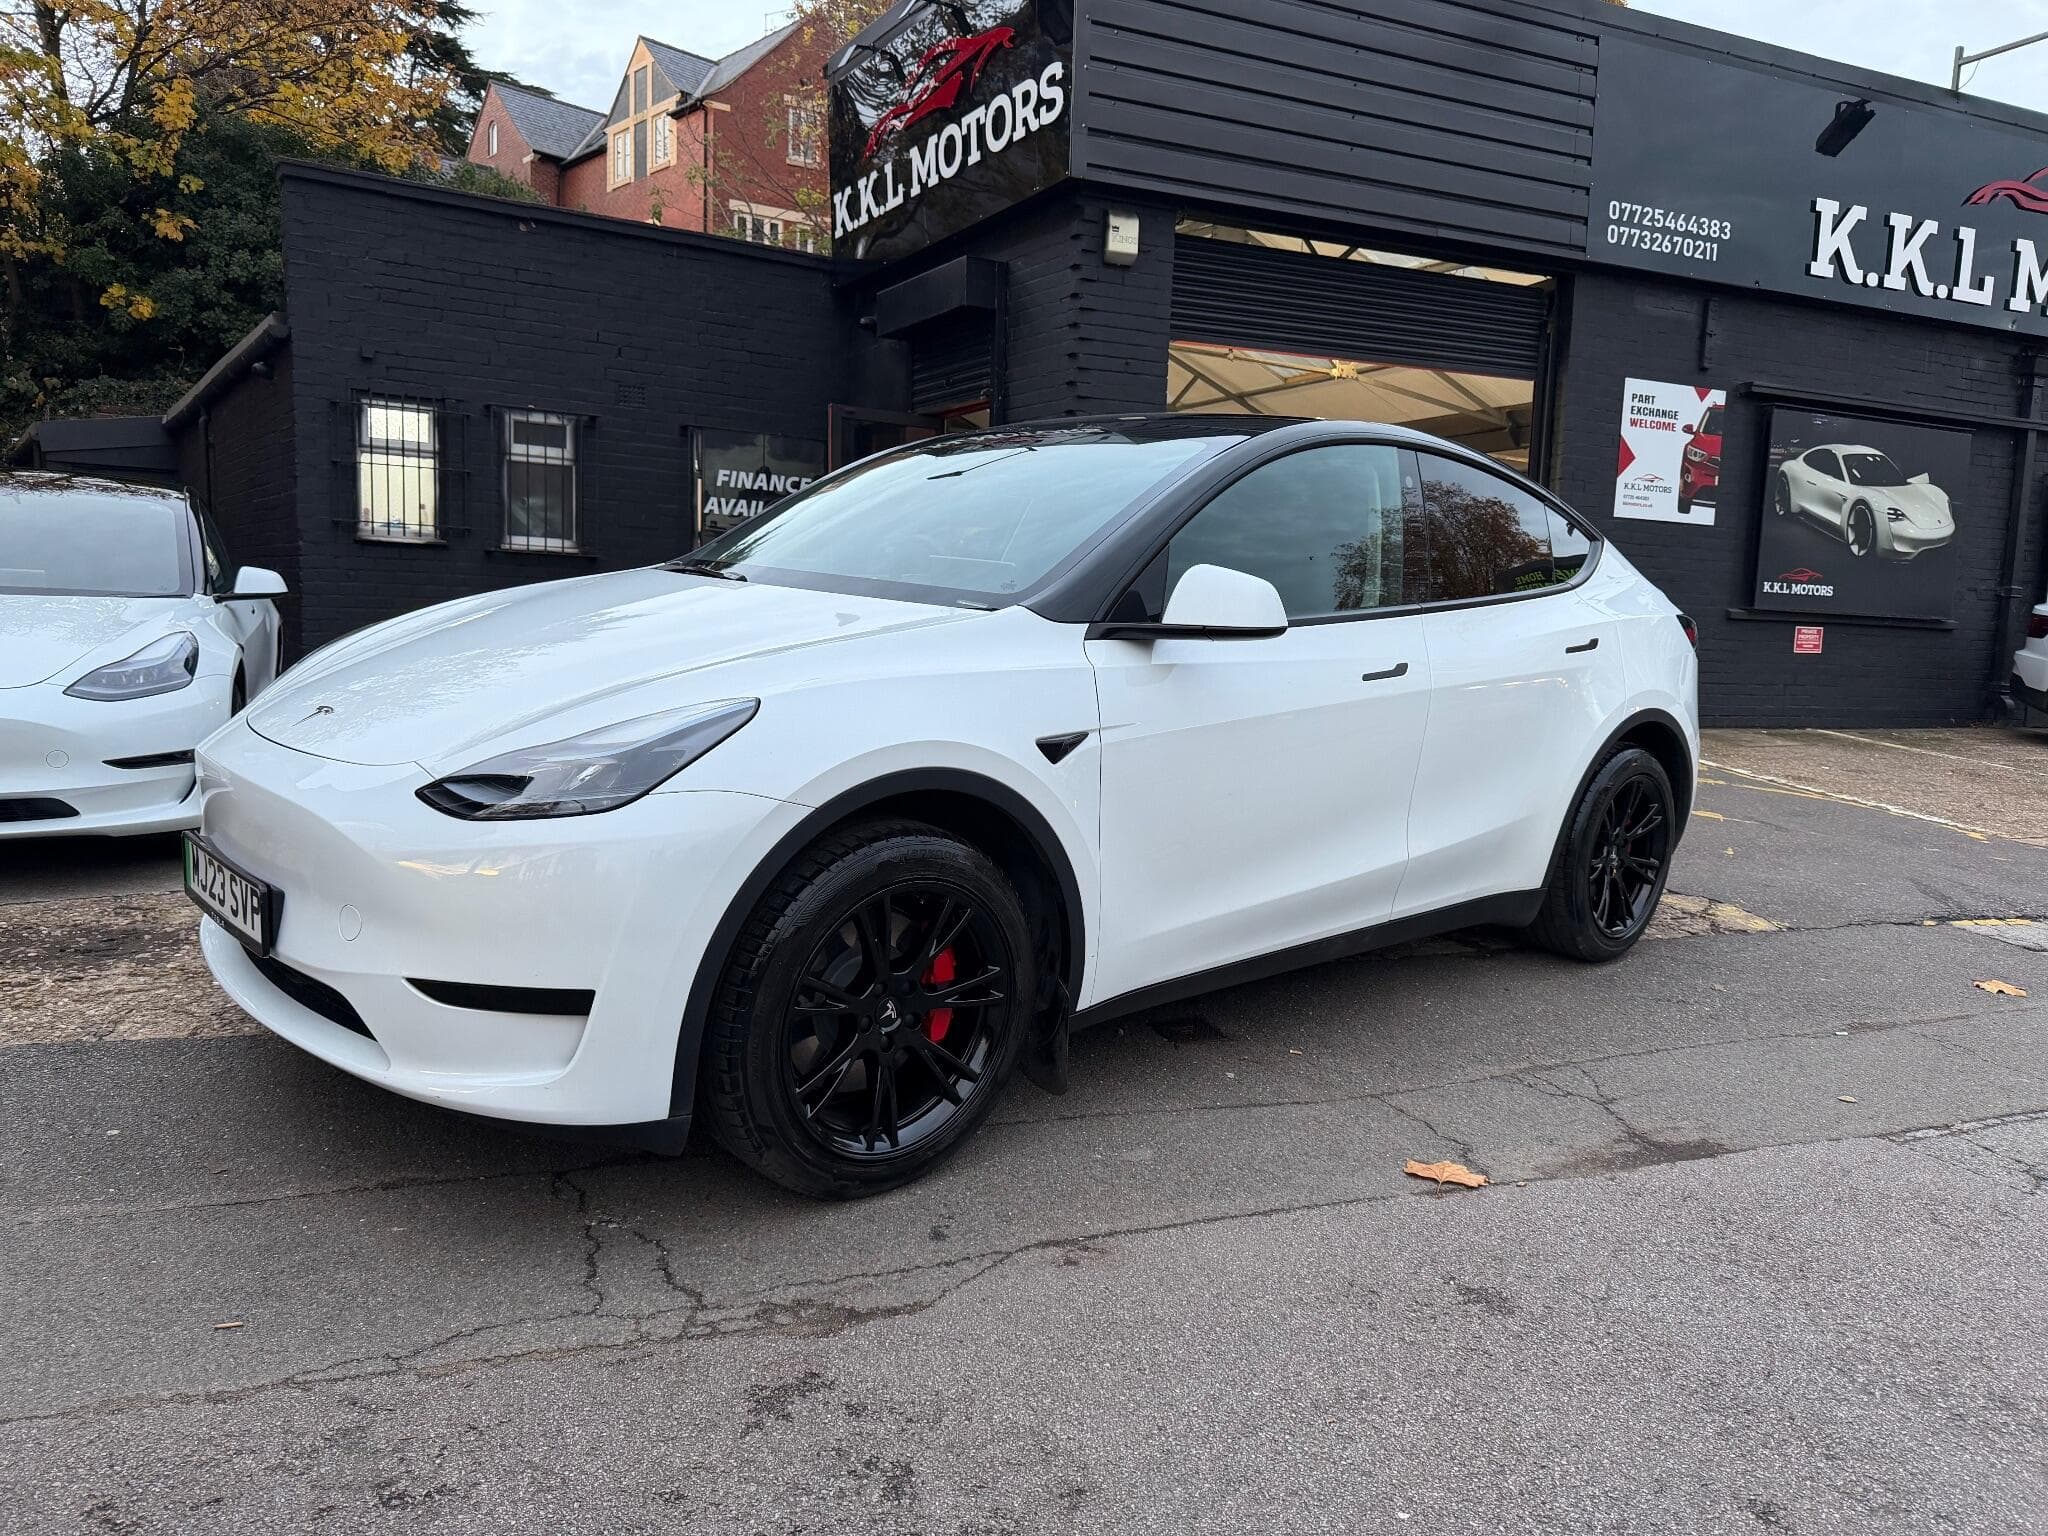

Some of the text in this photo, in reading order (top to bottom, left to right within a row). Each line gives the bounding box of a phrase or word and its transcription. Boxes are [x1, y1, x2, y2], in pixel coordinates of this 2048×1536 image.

[833, 61, 1065, 240] K.K.L MOTORS
[1608, 200, 1731, 240] 07725464383
[1607, 225, 1718, 262] 07732670211
[1810, 197, 1995, 306] K.K.L
[1632, 393, 1656, 405] PART
[1629, 417, 1677, 432] WELCOME
[1630, 405, 1679, 421] EXCHANGE
[1643, 484, 1672, 494] MOTORS
[1790, 583, 1834, 597] MOTORS
[191, 843, 261, 931] MJ23 SVP
